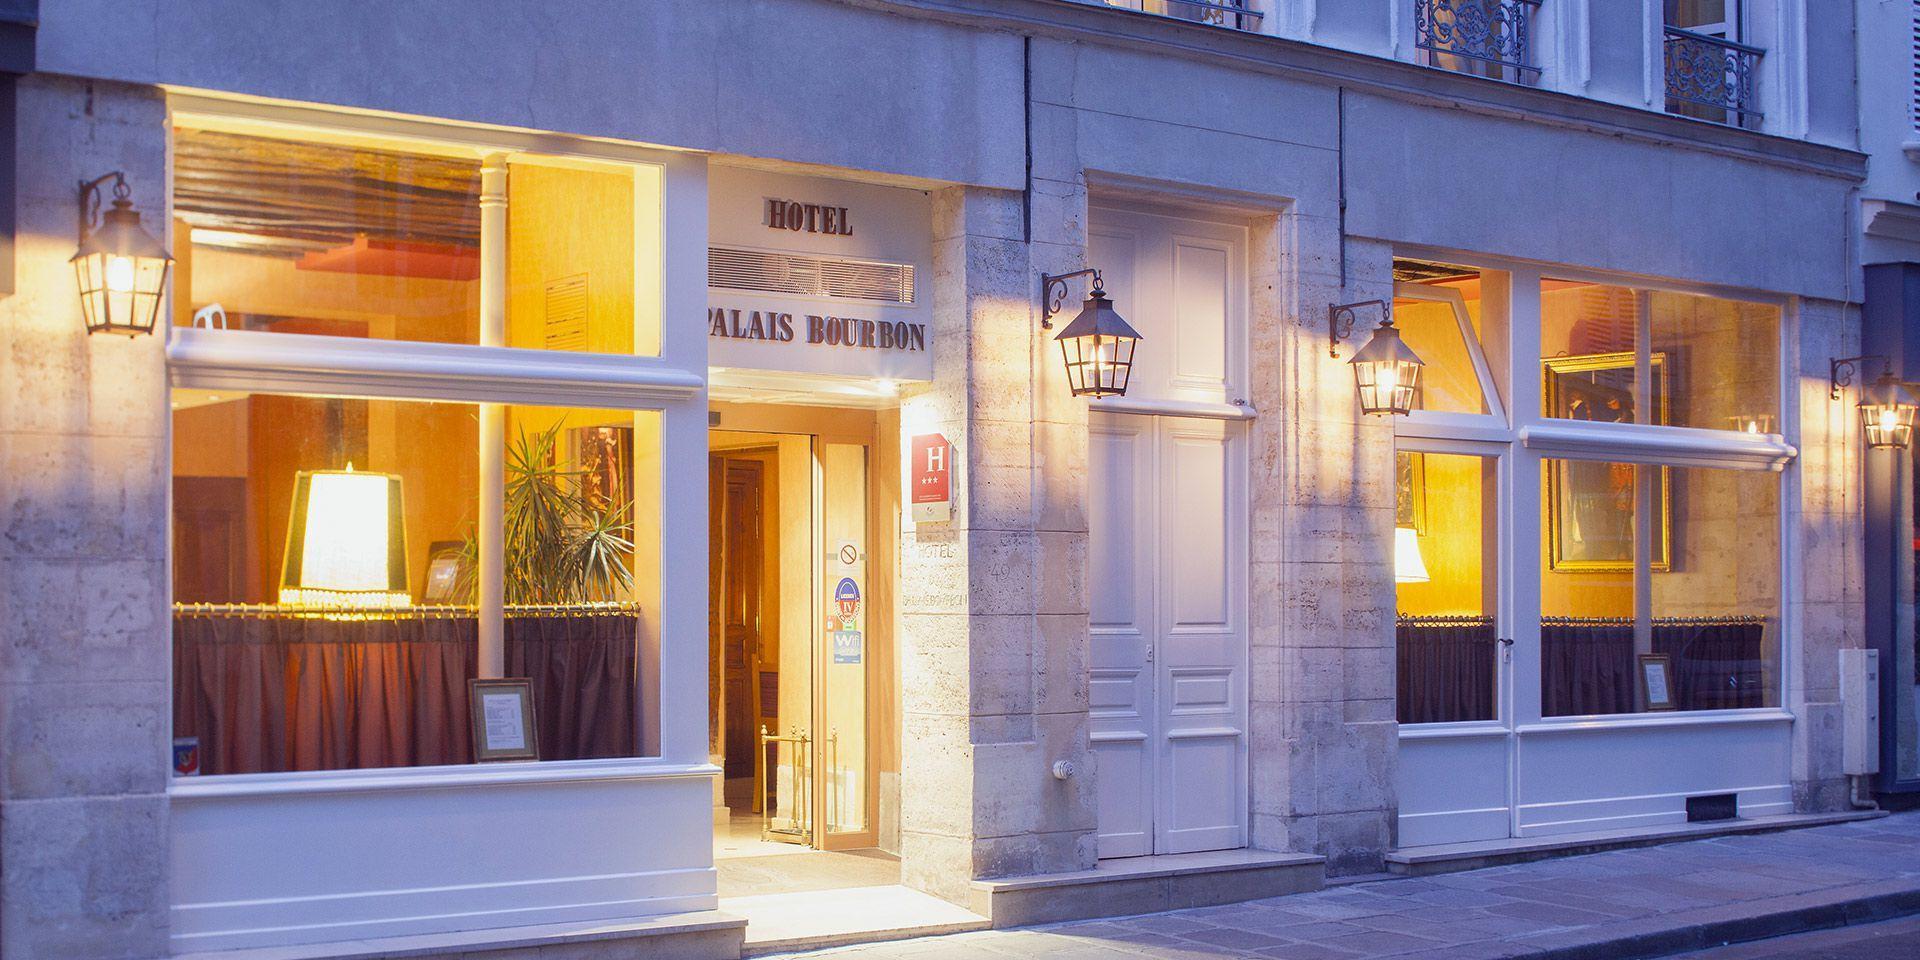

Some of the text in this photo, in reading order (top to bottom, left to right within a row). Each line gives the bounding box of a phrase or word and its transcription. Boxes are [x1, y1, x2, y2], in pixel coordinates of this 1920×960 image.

[767, 199, 853, 236] HOTEL
[708, 307, 925, 351] ALAIS BOURBON
[926, 446, 945, 473] H
